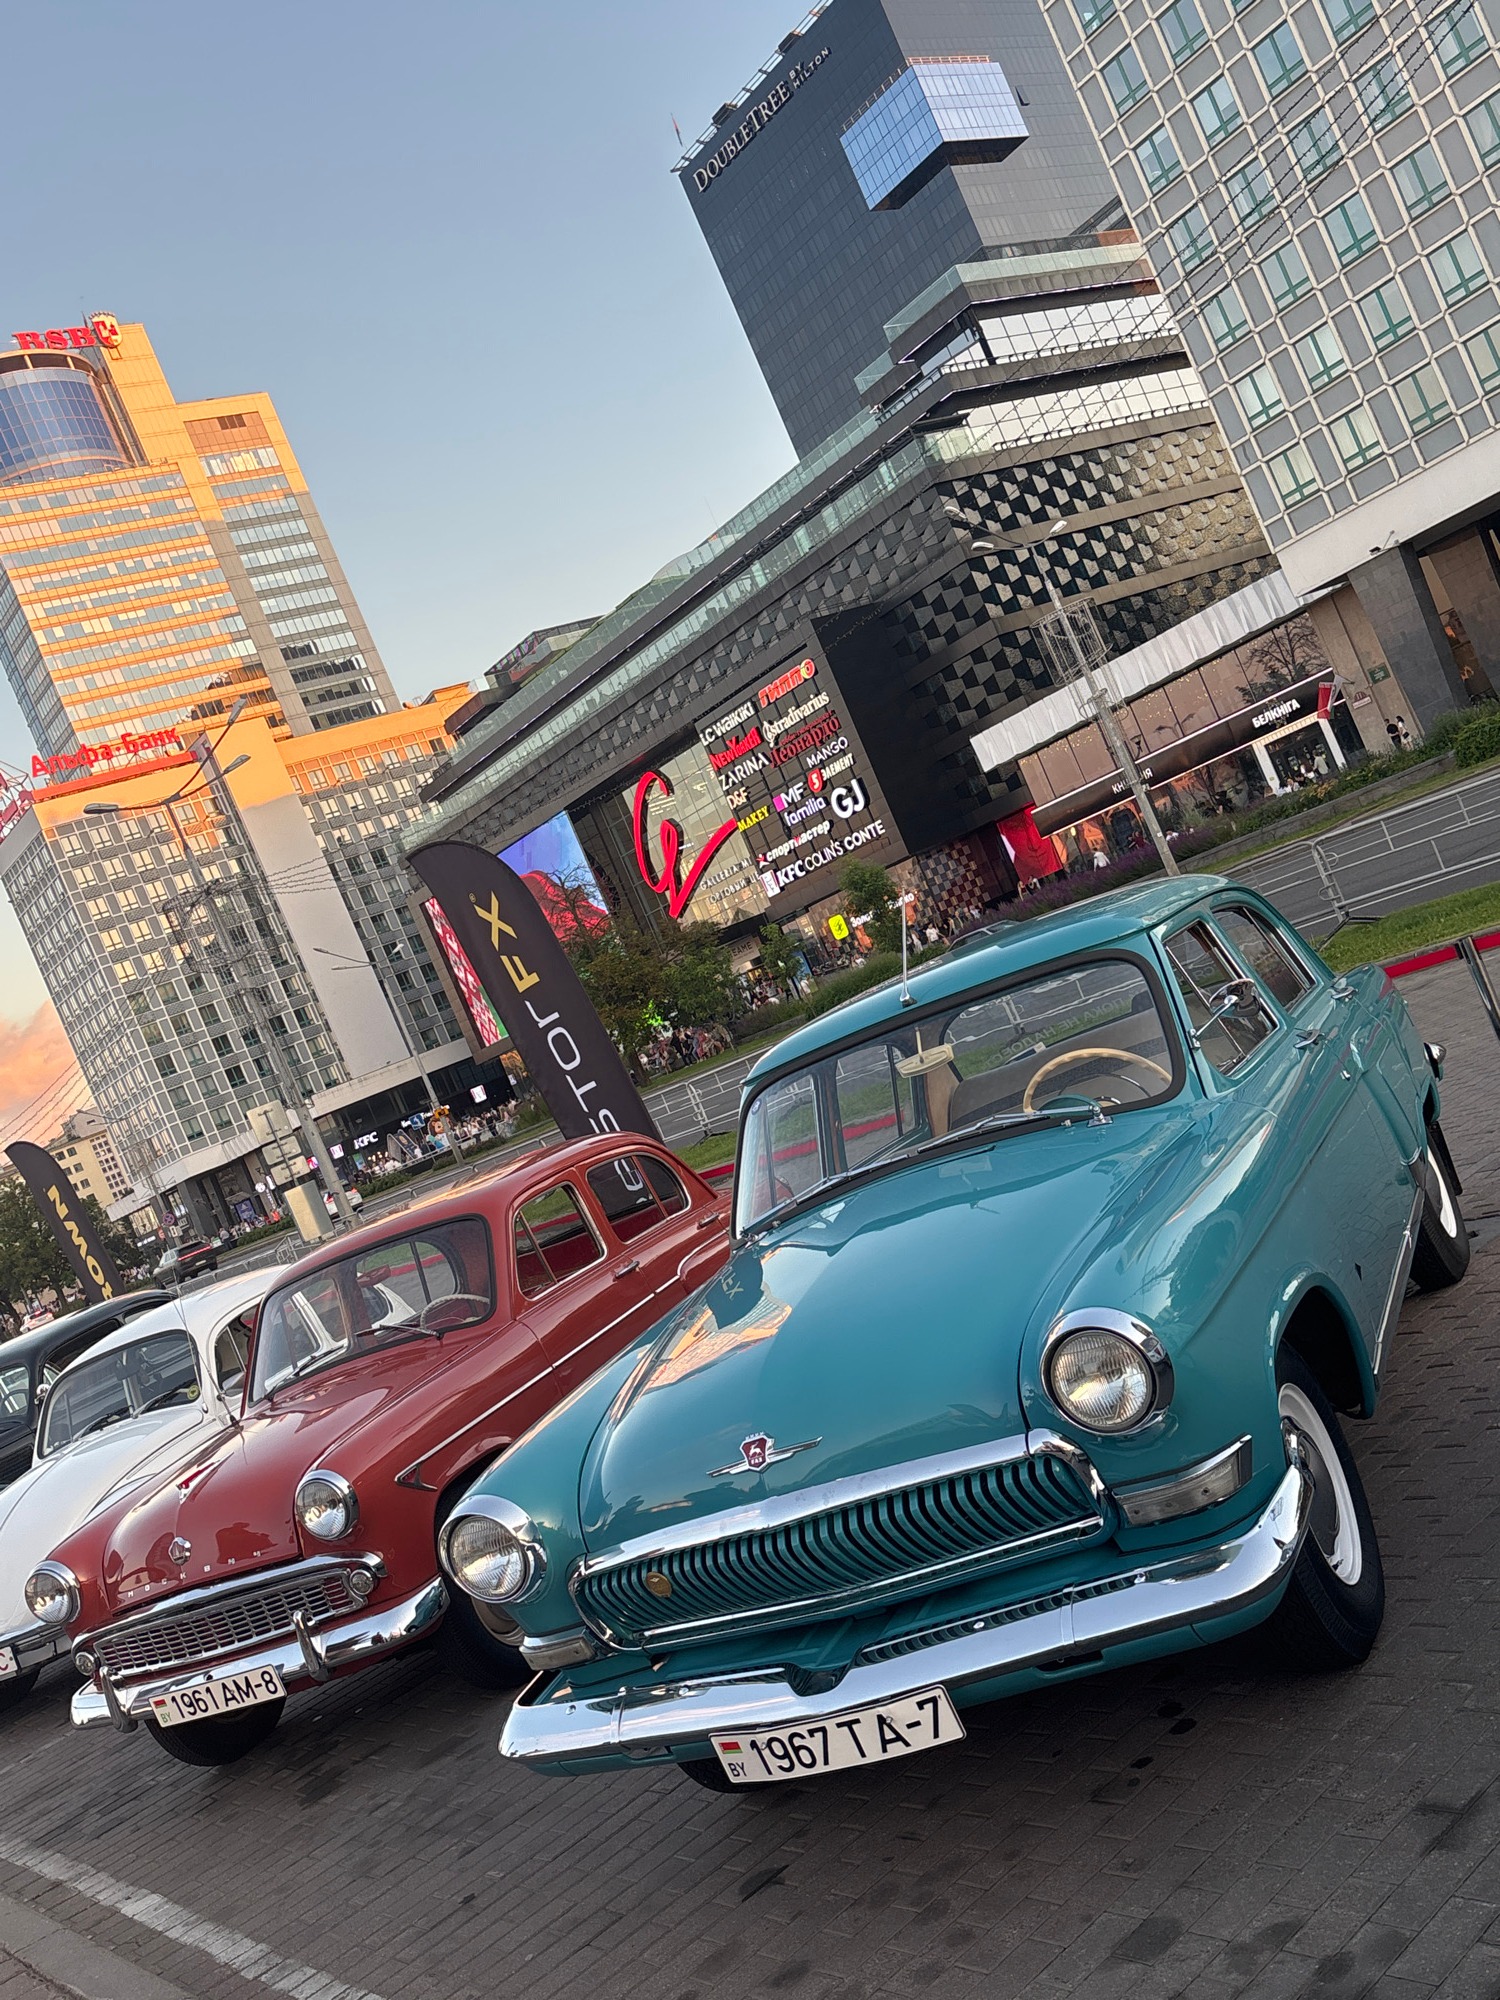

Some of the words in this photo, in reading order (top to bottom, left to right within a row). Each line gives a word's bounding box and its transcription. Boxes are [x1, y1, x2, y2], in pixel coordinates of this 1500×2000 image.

[789, 62, 803, 79] BY
[792, 47, 830, 90] HILTON
[12, 326, 97, 351] RSB
[758, 658, 816, 708] ГИППО
[1252, 698, 1301, 729] БЕЛКНІГА
[700, 727, 716, 747] LC
[770, 715, 841, 769] Леонардо
[806, 736, 849, 768] MANGO
[718, 752, 770, 791] ZARINA
[821, 753, 855, 781] ЭЛЕМЕНТ
[780, 781, 805, 809] MF
[830, 778, 866, 819] GJ
[737, 805, 770, 832] MAKEY
[784, 797, 827, 827] familia
[766, 820, 831, 862] спортмастер
[776, 860, 807, 887] KFC
[804, 840, 844, 871] COLIN'S
[843, 819, 886, 851] CONTE
[700, 864, 741, 890] GALLERIA
[353, 1131, 379, 1150] KFC
[171, 1686, 220, 1718] 1961
[221, 1670, 279, 1707] AM-8
[160, 1712, 171, 1724] BY
[749, 1725, 831, 1777] 1967
[728, 1761, 748, 1778] BY
